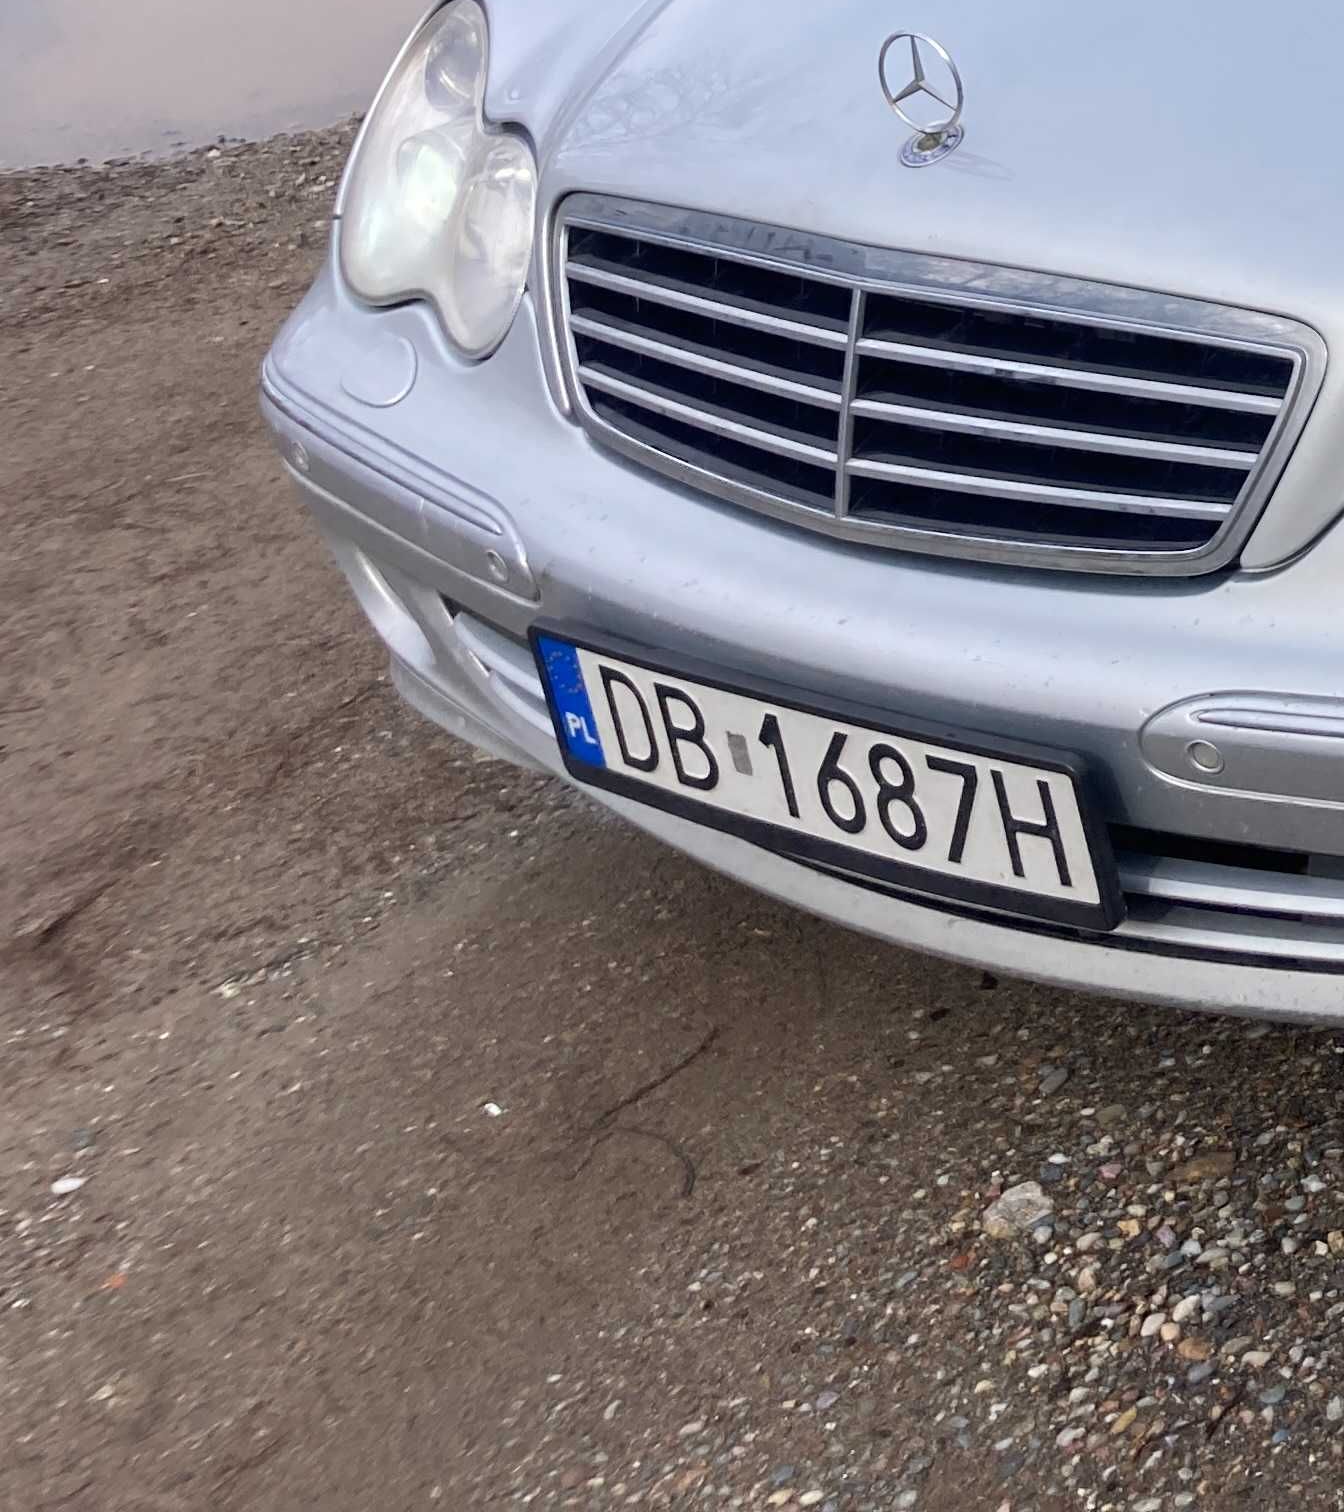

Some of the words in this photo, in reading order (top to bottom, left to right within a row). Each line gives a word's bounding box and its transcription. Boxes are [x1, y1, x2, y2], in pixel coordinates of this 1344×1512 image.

[564, 711, 597, 744] PL
[598, 663, 720, 791] DB
[758, 712, 1073, 888] 1687H
